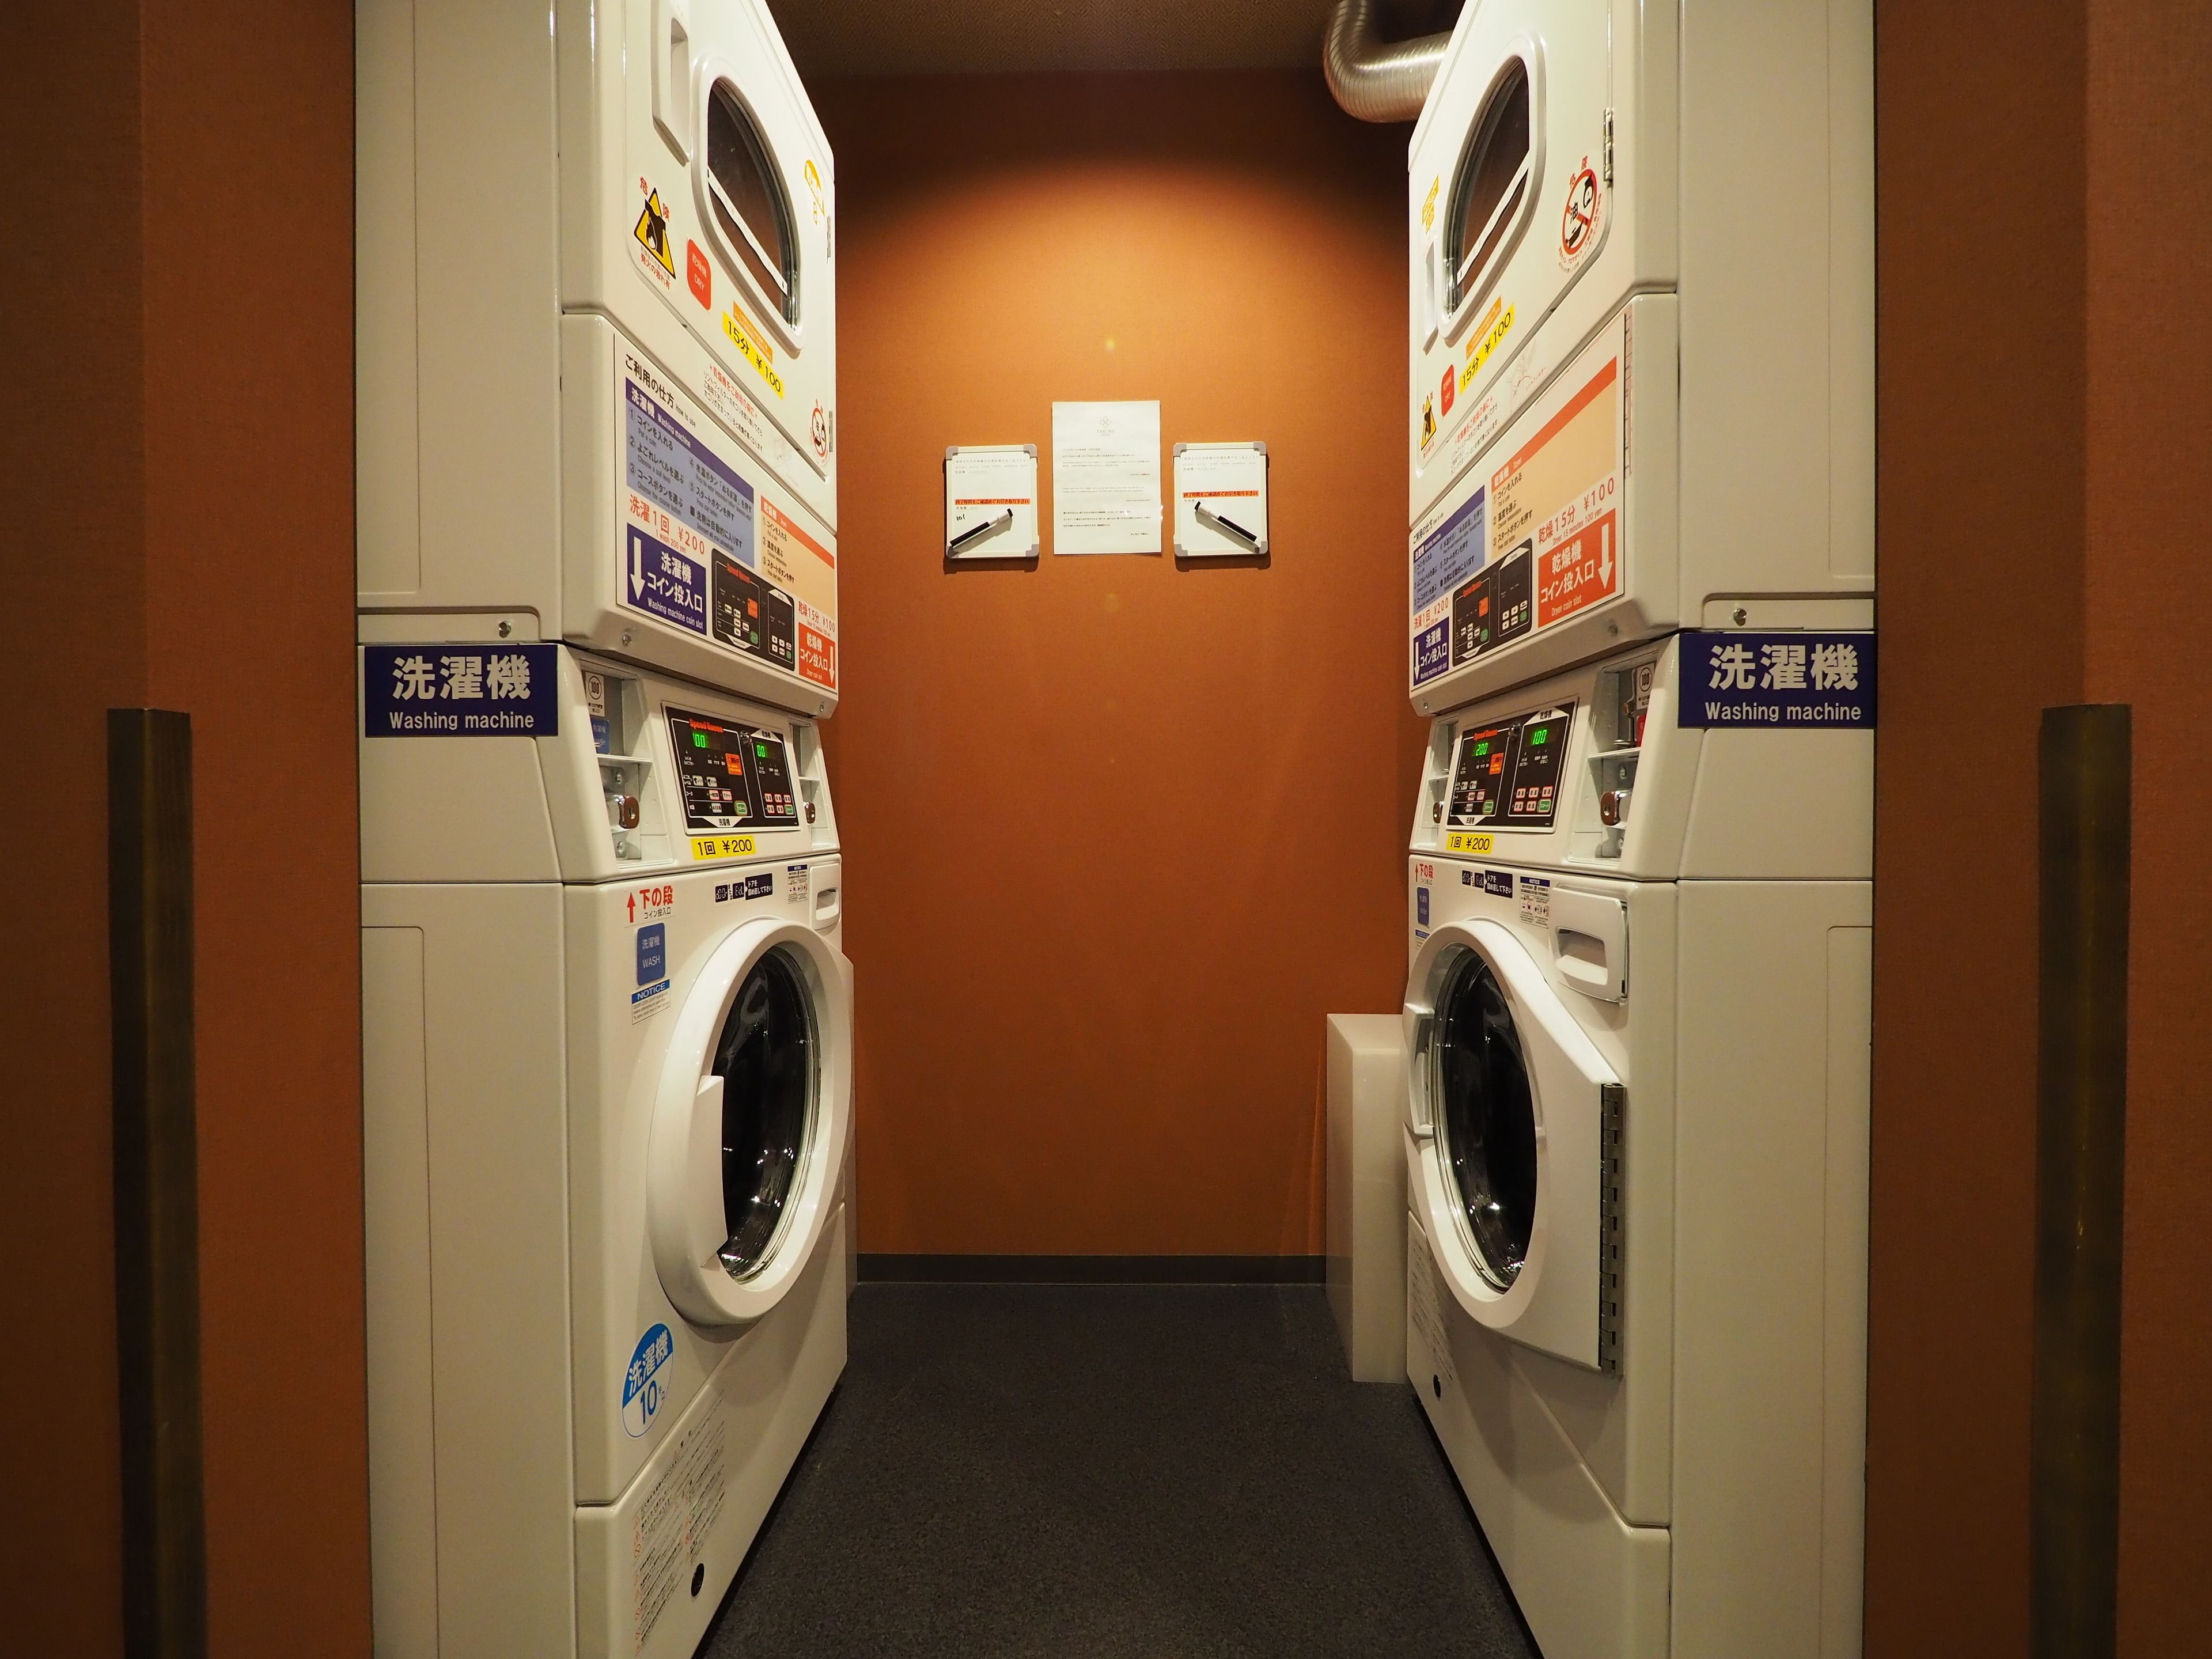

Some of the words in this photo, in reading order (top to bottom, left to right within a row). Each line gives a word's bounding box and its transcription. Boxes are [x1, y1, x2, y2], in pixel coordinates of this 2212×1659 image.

[1569, 173, 1577, 189] 危
[1570, 201, 1578, 224] 油
[694, 273, 705, 291] DRY
[728, 321, 749, 354] 15分
[756, 354, 781, 392] ¥100
[1462, 357, 1479, 387] 15分
[1484, 312, 1511, 354] ¥100
[626, 354, 675, 409] ご利用の仕方
[637, 415, 673, 451] コインを入れる
[1584, 477, 1614, 512] ¥100
[956, 513, 965, 521] 101
[1569, 520, 1584, 535] minutes
[1585, 514, 1593, 524] 100
[1594, 507, 1602, 520] yen
[659, 532, 669, 544] wash
[671, 539, 679, 550] 200
[677, 525, 705, 555] ¥200
[661, 550, 692, 586] 洗濯機
[1551, 539, 1582, 575] 乾燥機
[647, 571, 703, 614] コイン投入口
[1541, 559, 1594, 603] コイン投入口
[647, 597, 667, 615] Washing
[667, 607, 685, 623] machine
[686, 615, 695, 626] coin
[695, 619, 703, 630] slot
[1434, 597, 1449, 615] ¥200
[1551, 603, 1562, 618] Dryer
[1563, 599, 1573, 611] coin
[1573, 594, 1582, 606] slot
[1426, 627, 1441, 649] 洗濯機
[800, 647, 828, 672] コイン投入口
[1420, 642, 1447, 667] コイン投入口
[392, 654, 531, 700] 洗濯機
[1709, 643, 1858, 691] 洗濯機
[389, 711, 458, 730] Washing
[465, 711, 535, 729] machine
[1705, 702, 1779, 722] Washing
[1787, 702, 1862, 721] machine
[1475, 742, 1488, 756] 200
[1533, 729, 1547, 745] 100
[698, 841, 716, 856] 1回
[722, 839, 752, 853] ¥200
[1450, 836, 1462, 849] 1回
[1466, 837, 1490, 850] ¥200
[1419, 863, 1433, 878] 下の段
[639, 885, 673, 910] 下の段
[644, 907, 672, 919] コイン投入口
[642, 934, 660, 950] 洗濯機
[642, 954, 661, 968] WASH
[637, 981, 665, 1000] NOTICE
[628, 1330, 669, 1397] 洗濯機
[641, 1380, 657, 1425] 10
